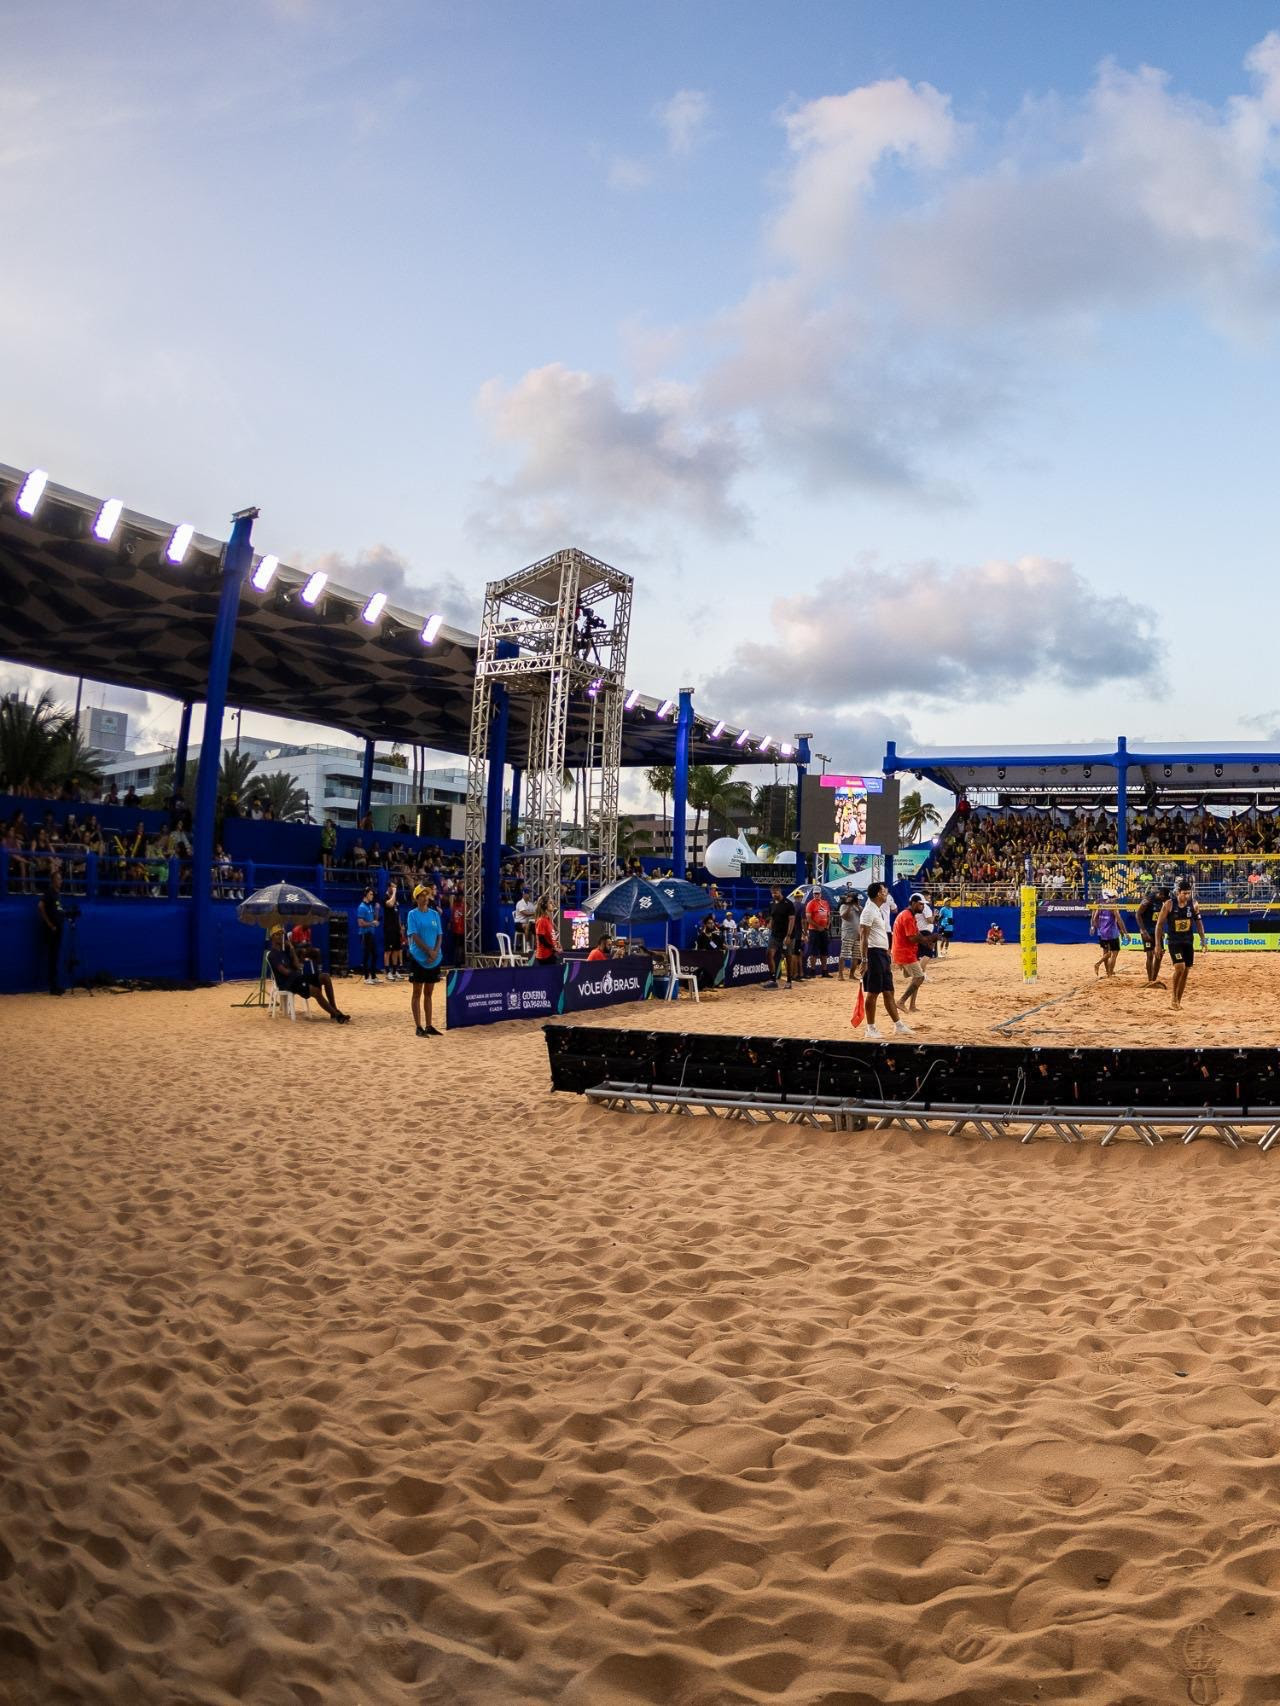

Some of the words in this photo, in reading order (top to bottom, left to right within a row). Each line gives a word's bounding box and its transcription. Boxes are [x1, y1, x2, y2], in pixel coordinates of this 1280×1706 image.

[578, 980, 603, 996] VÔLEI
[613, 977, 640, 992] BRASIL
[522, 991, 547, 1000] GOVERNO
